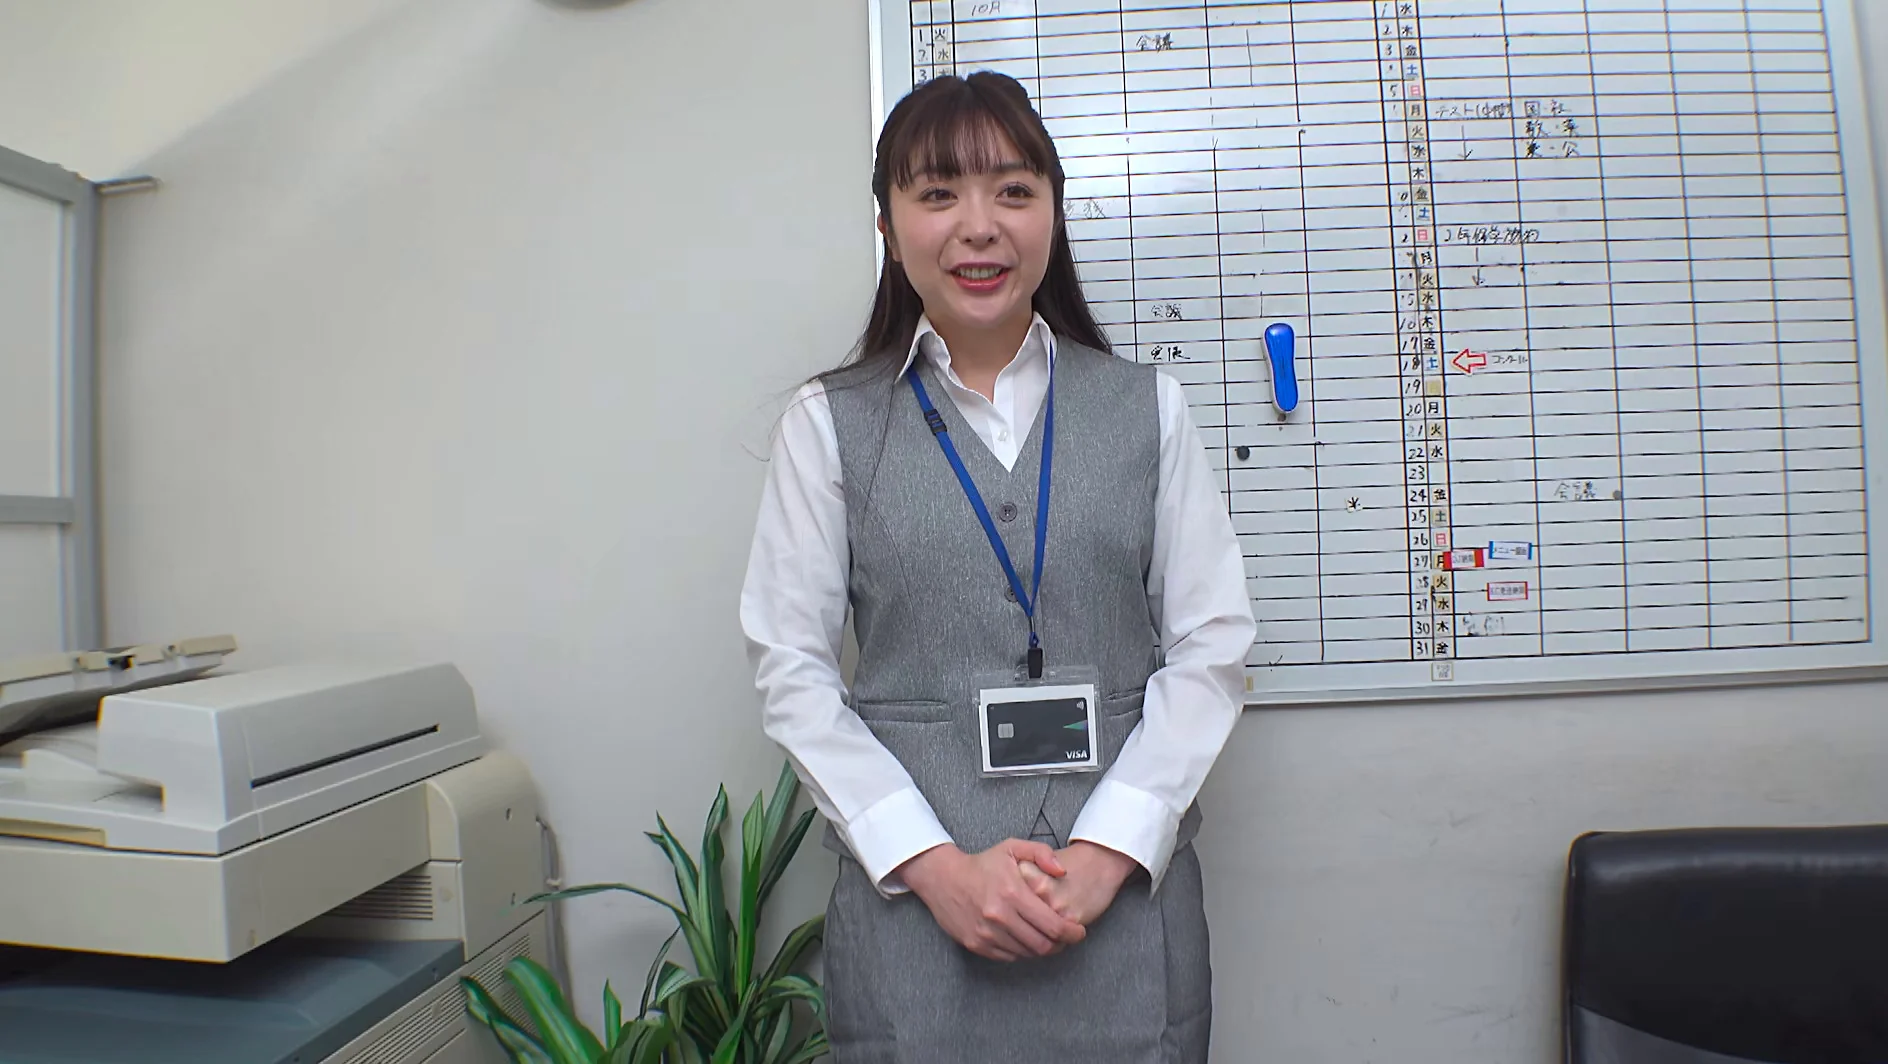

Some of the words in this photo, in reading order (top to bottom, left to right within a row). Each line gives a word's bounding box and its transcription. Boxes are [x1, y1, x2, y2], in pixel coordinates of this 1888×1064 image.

[934, 27, 946, 40] 火
[1383, 24, 1393, 35] 2
[937, 49, 949, 60] 水
[1384, 44, 1393, 56] 3
[1405, 43, 1417, 57] 金
[918, 69, 928, 82] 3
[1406, 63, 1419, 77] 土
[1389, 83, 1398, 98] 5
[1410, 85, 1421, 97] 日
[1410, 103, 1422, 116] 月
[1411, 125, 1425, 138] 火
[1411, 144, 1427, 158] 水
[1412, 166, 1426, 179] 木
[1418, 207, 1431, 219] 土
[1417, 229, 1429, 241] 日
[1422, 273, 1434, 286] 火
[1421, 292, 1434, 305] 水
[1421, 316, 1434, 329] 木
[1402, 336, 1419, 352] 17
[1423, 337, 1436, 349] 金
[1402, 356, 1421, 371] 18
[1426, 357, 1439, 369] 土
[1404, 378, 1422, 395] 19
[1406, 403, 1422, 417] 20
[1427, 401, 1440, 415] 月
[1430, 424, 1443, 436] 火
[1408, 447, 1426, 461] 22
[1430, 445, 1444, 458] 水
[1408, 465, 1426, 480] 23
[1409, 488, 1427, 502] 24
[1433, 488, 1448, 502] 金
[1411, 510, 1428, 524] 25
[1435, 511, 1448, 523] 土
[1412, 533, 1429, 546] 26
[1435, 532, 1448, 545] 日
[1435, 575, 1448, 588] 火
[1416, 598, 1429, 611] 29
[1437, 598, 1450, 611] 水
[1414, 621, 1431, 635] 30
[1436, 620, 1449, 633] 木
[1416, 641, 1430, 656] 31
[1435, 641, 1449, 655] 金
[1065, 749, 1088, 760] VISA
